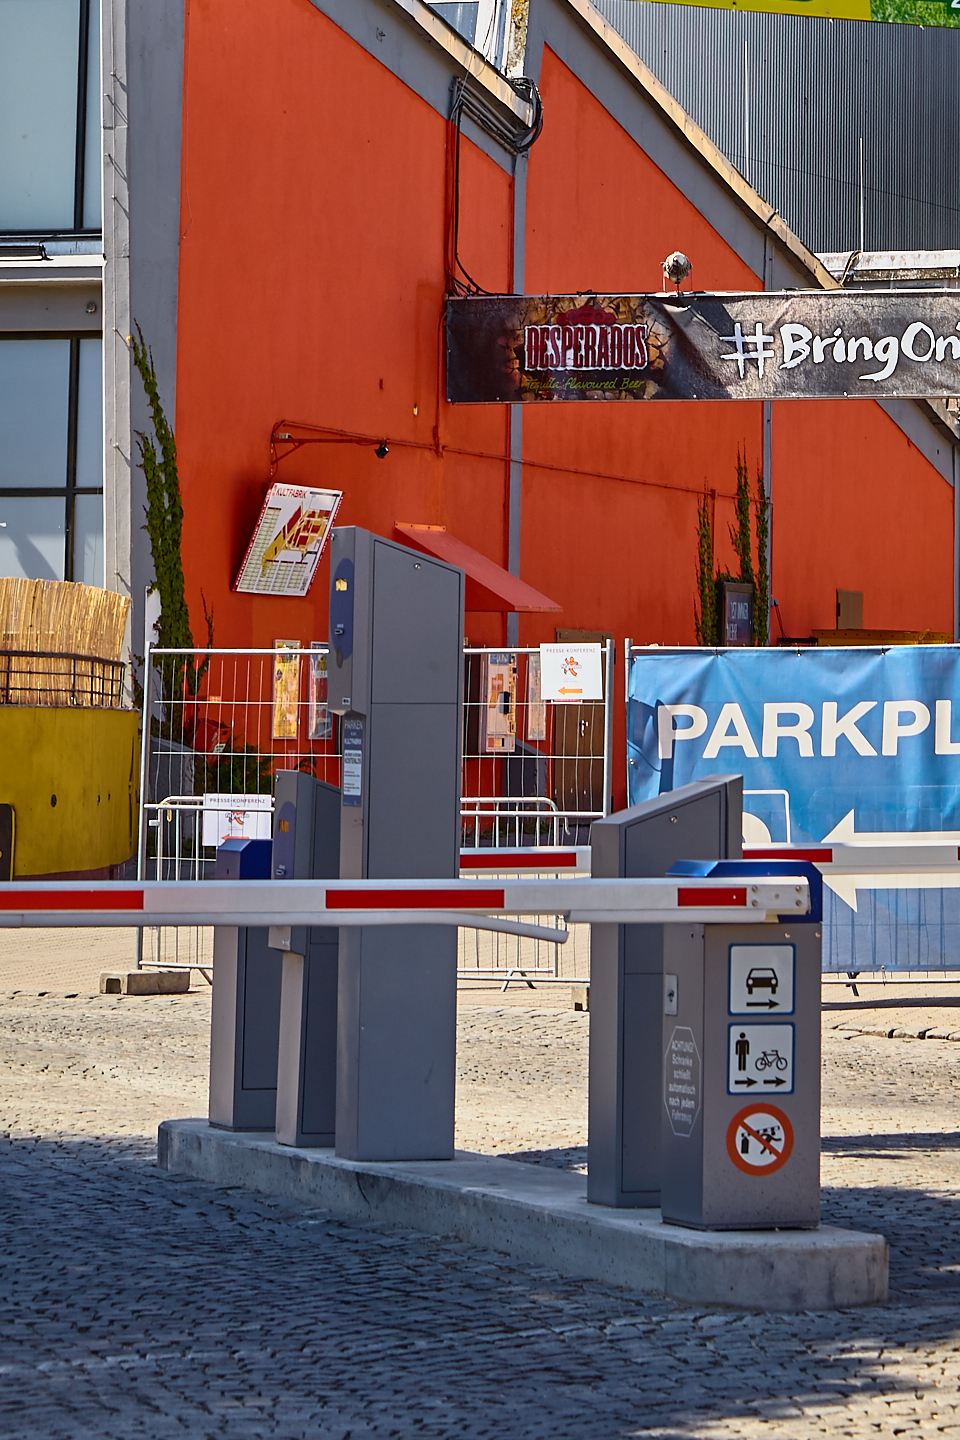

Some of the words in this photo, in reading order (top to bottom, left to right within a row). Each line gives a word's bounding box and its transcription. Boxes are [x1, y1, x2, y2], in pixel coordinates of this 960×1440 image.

[525, 325, 648, 370] DESPERADOS
[527, 378, 560, 393] Tequila
[620, 377, 644, 390] Beer
[672, 1053, 693, 1067] Schranke
[668, 1083, 696, 1095] automatisch
[668, 1097, 680, 1106] nach
[681, 1097, 695, 1109] jedem
[671, 1109, 692, 1125] Fahrzeug
